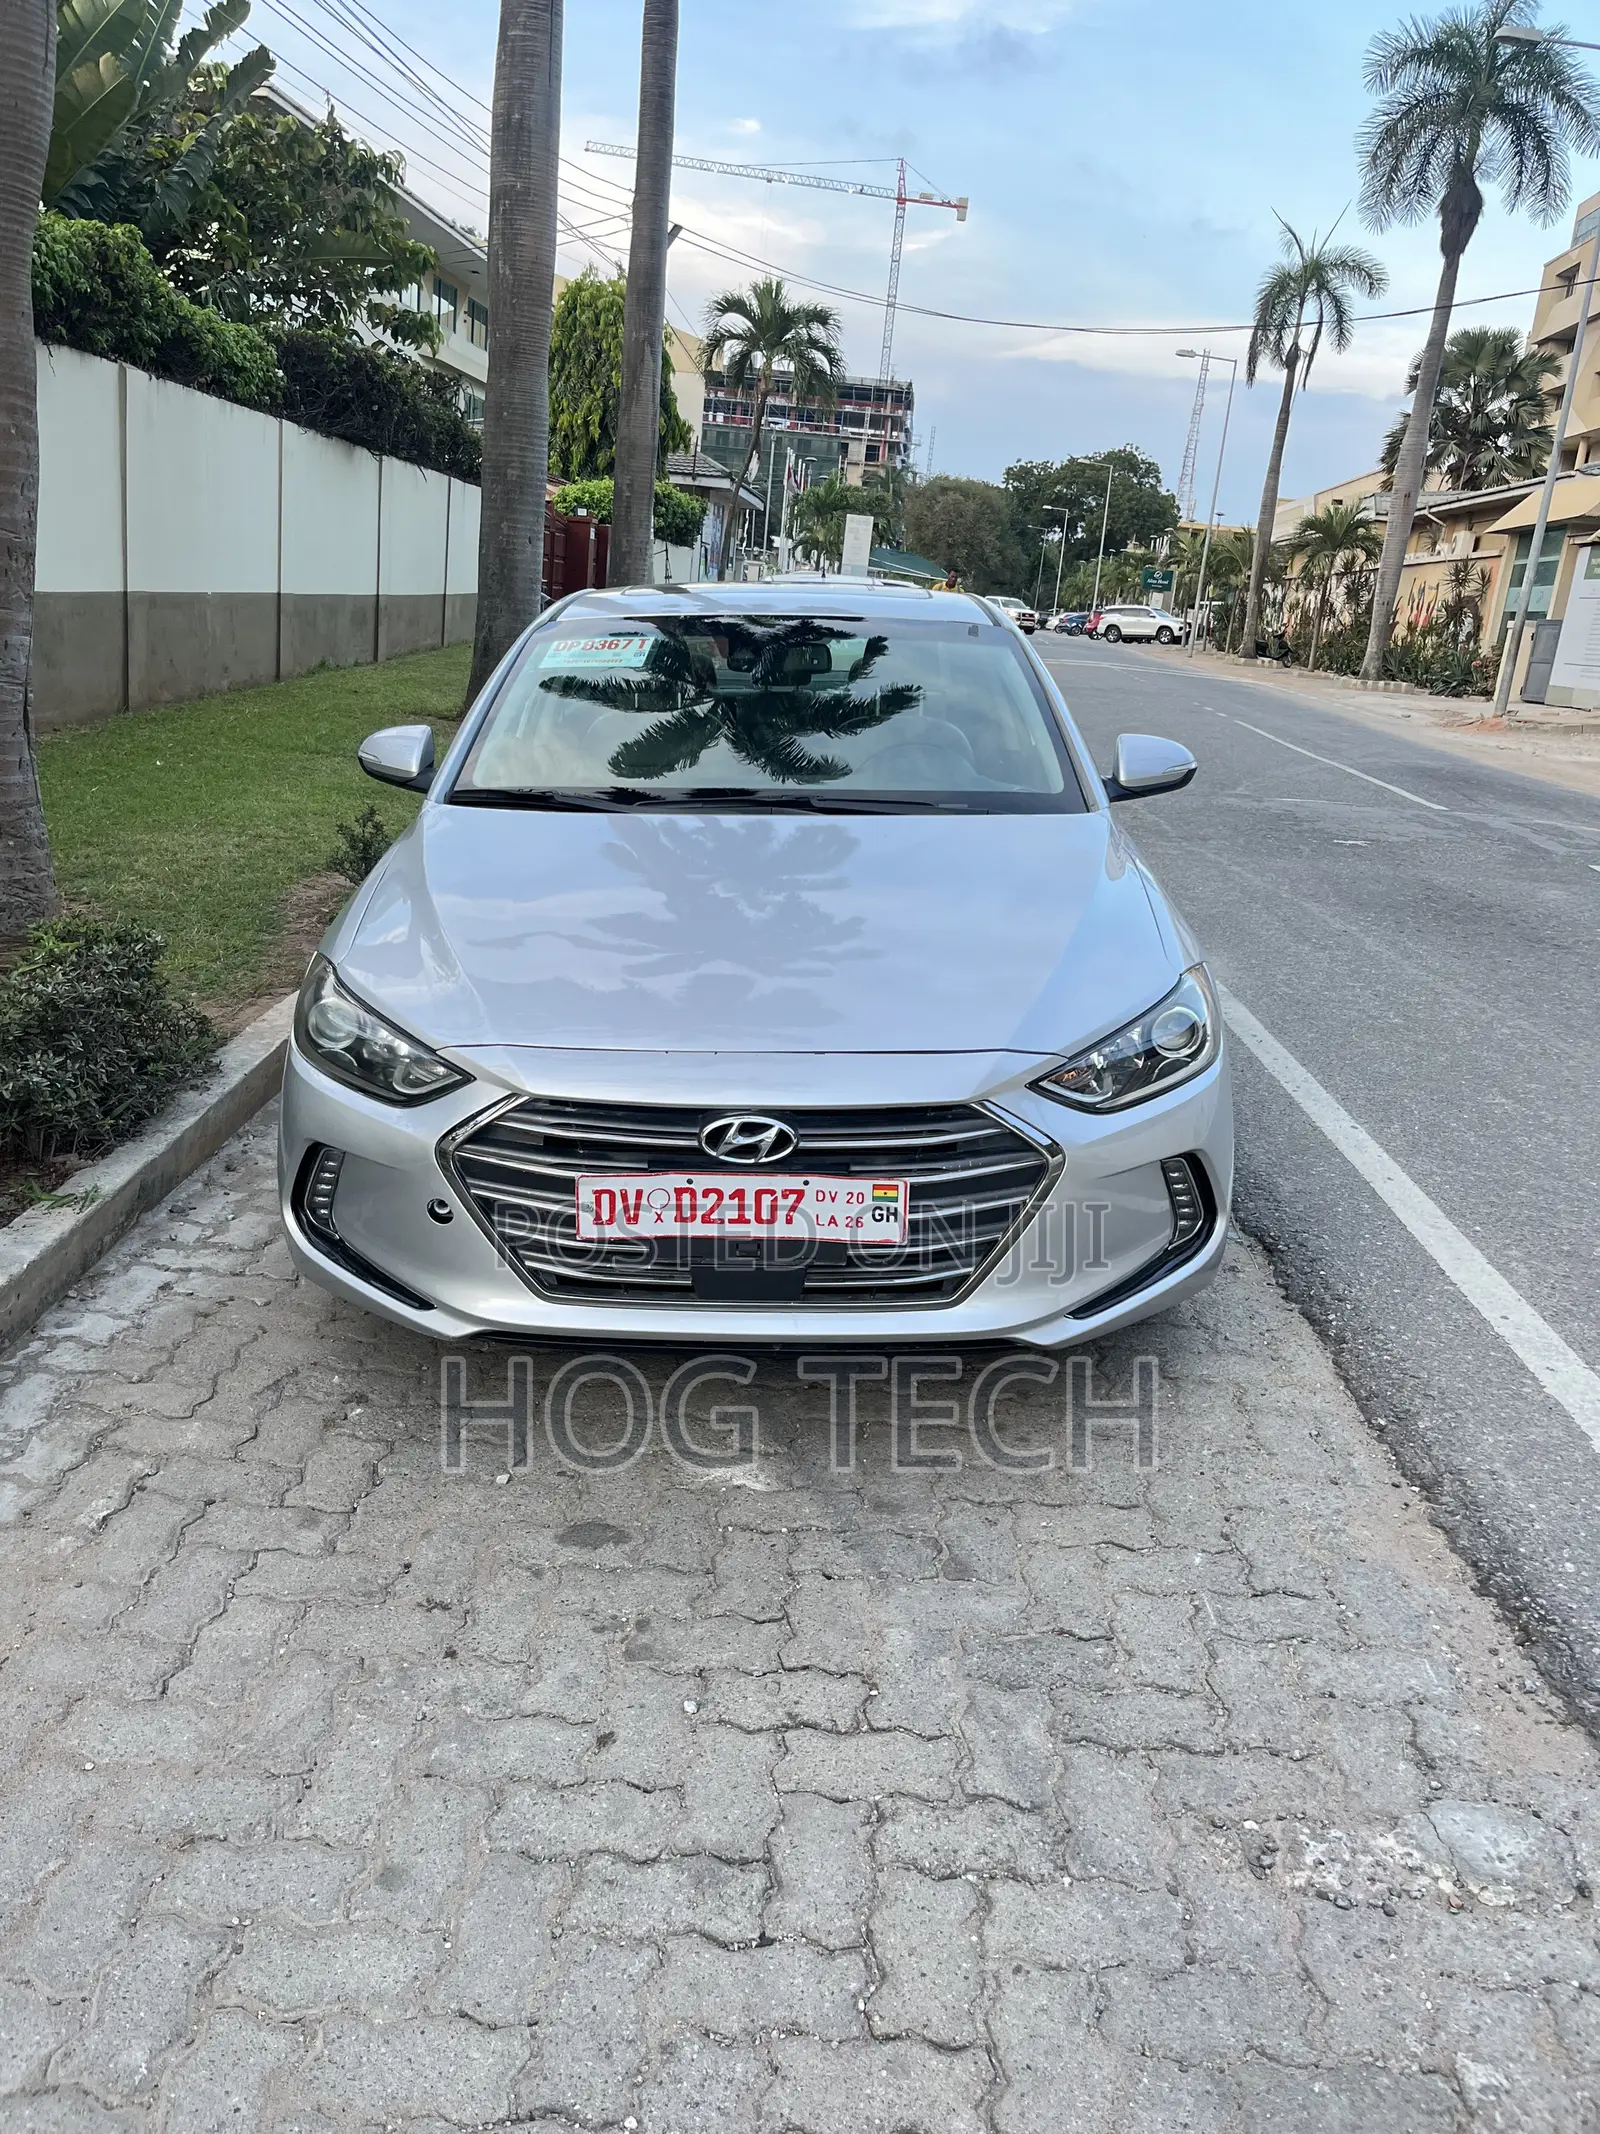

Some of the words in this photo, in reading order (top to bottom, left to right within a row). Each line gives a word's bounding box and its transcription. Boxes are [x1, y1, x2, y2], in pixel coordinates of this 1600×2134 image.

[815, 1189, 838, 1204] DV
[845, 1191, 865, 1205] 20
[592, 1188, 643, 1225] DV
[673, 1187, 806, 1225] D2107
[871, 1205, 899, 1223] GH
[815, 1213, 839, 1228] LA
[844, 1215, 865, 1229] 26
